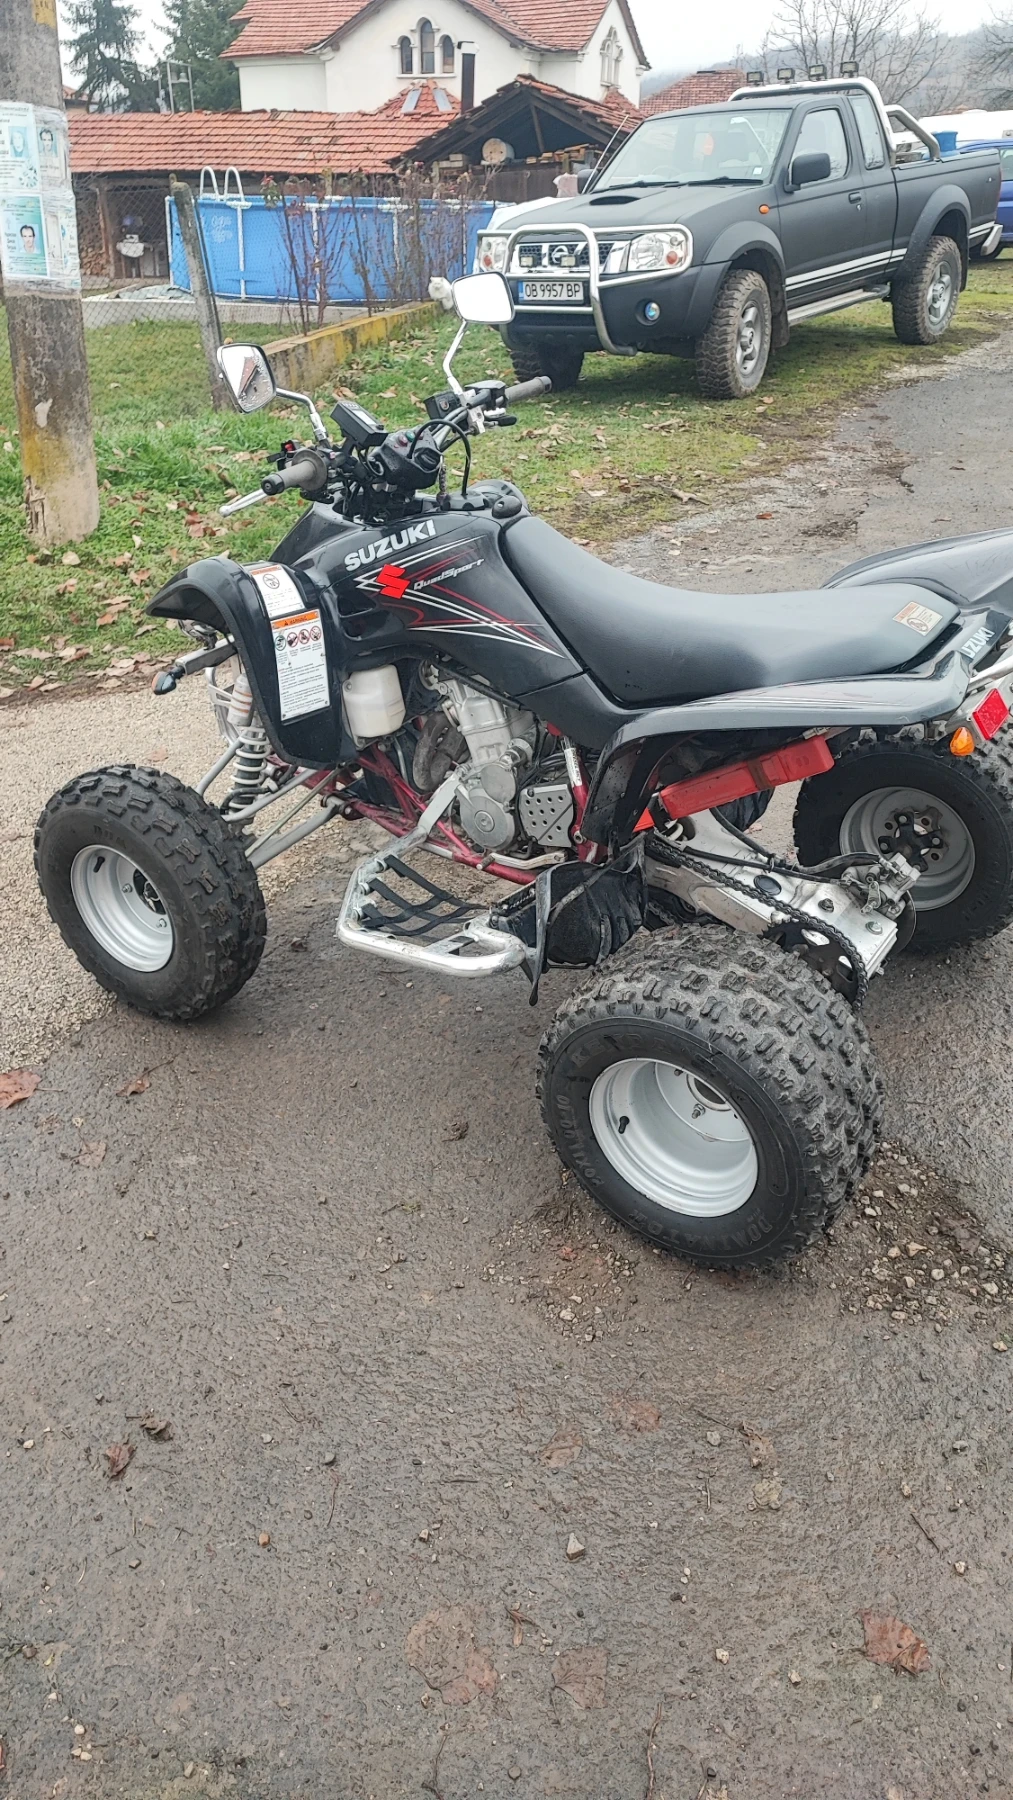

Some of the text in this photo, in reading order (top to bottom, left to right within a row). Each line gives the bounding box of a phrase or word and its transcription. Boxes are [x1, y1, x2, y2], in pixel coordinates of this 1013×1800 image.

[525, 283, 581, 298] OB 9957 BP
[344, 519, 437, 572] SUZUKI
[961, 626, 996, 659] UZUKI
